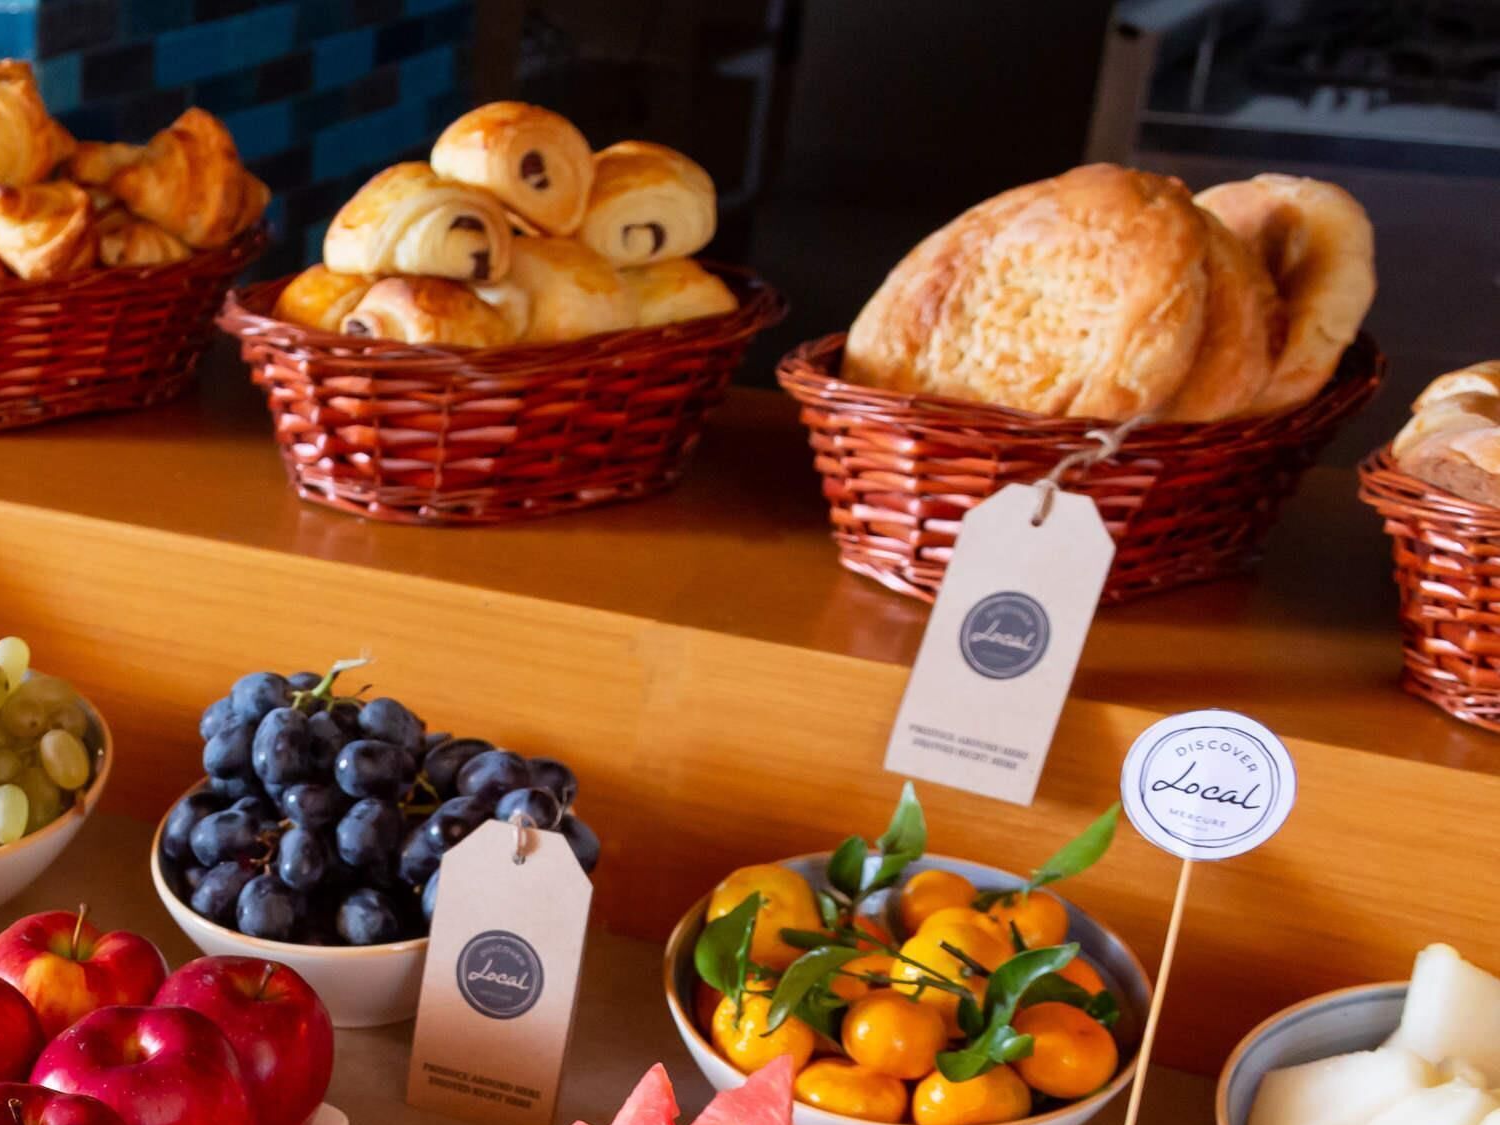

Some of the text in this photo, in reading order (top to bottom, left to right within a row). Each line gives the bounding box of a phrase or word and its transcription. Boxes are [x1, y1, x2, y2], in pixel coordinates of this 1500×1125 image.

[970, 618, 1036, 650] Local
[1175, 740, 1259, 773] DISCOVER
[1152, 761, 1260, 809] Local
[468, 959, 530, 990] Local
